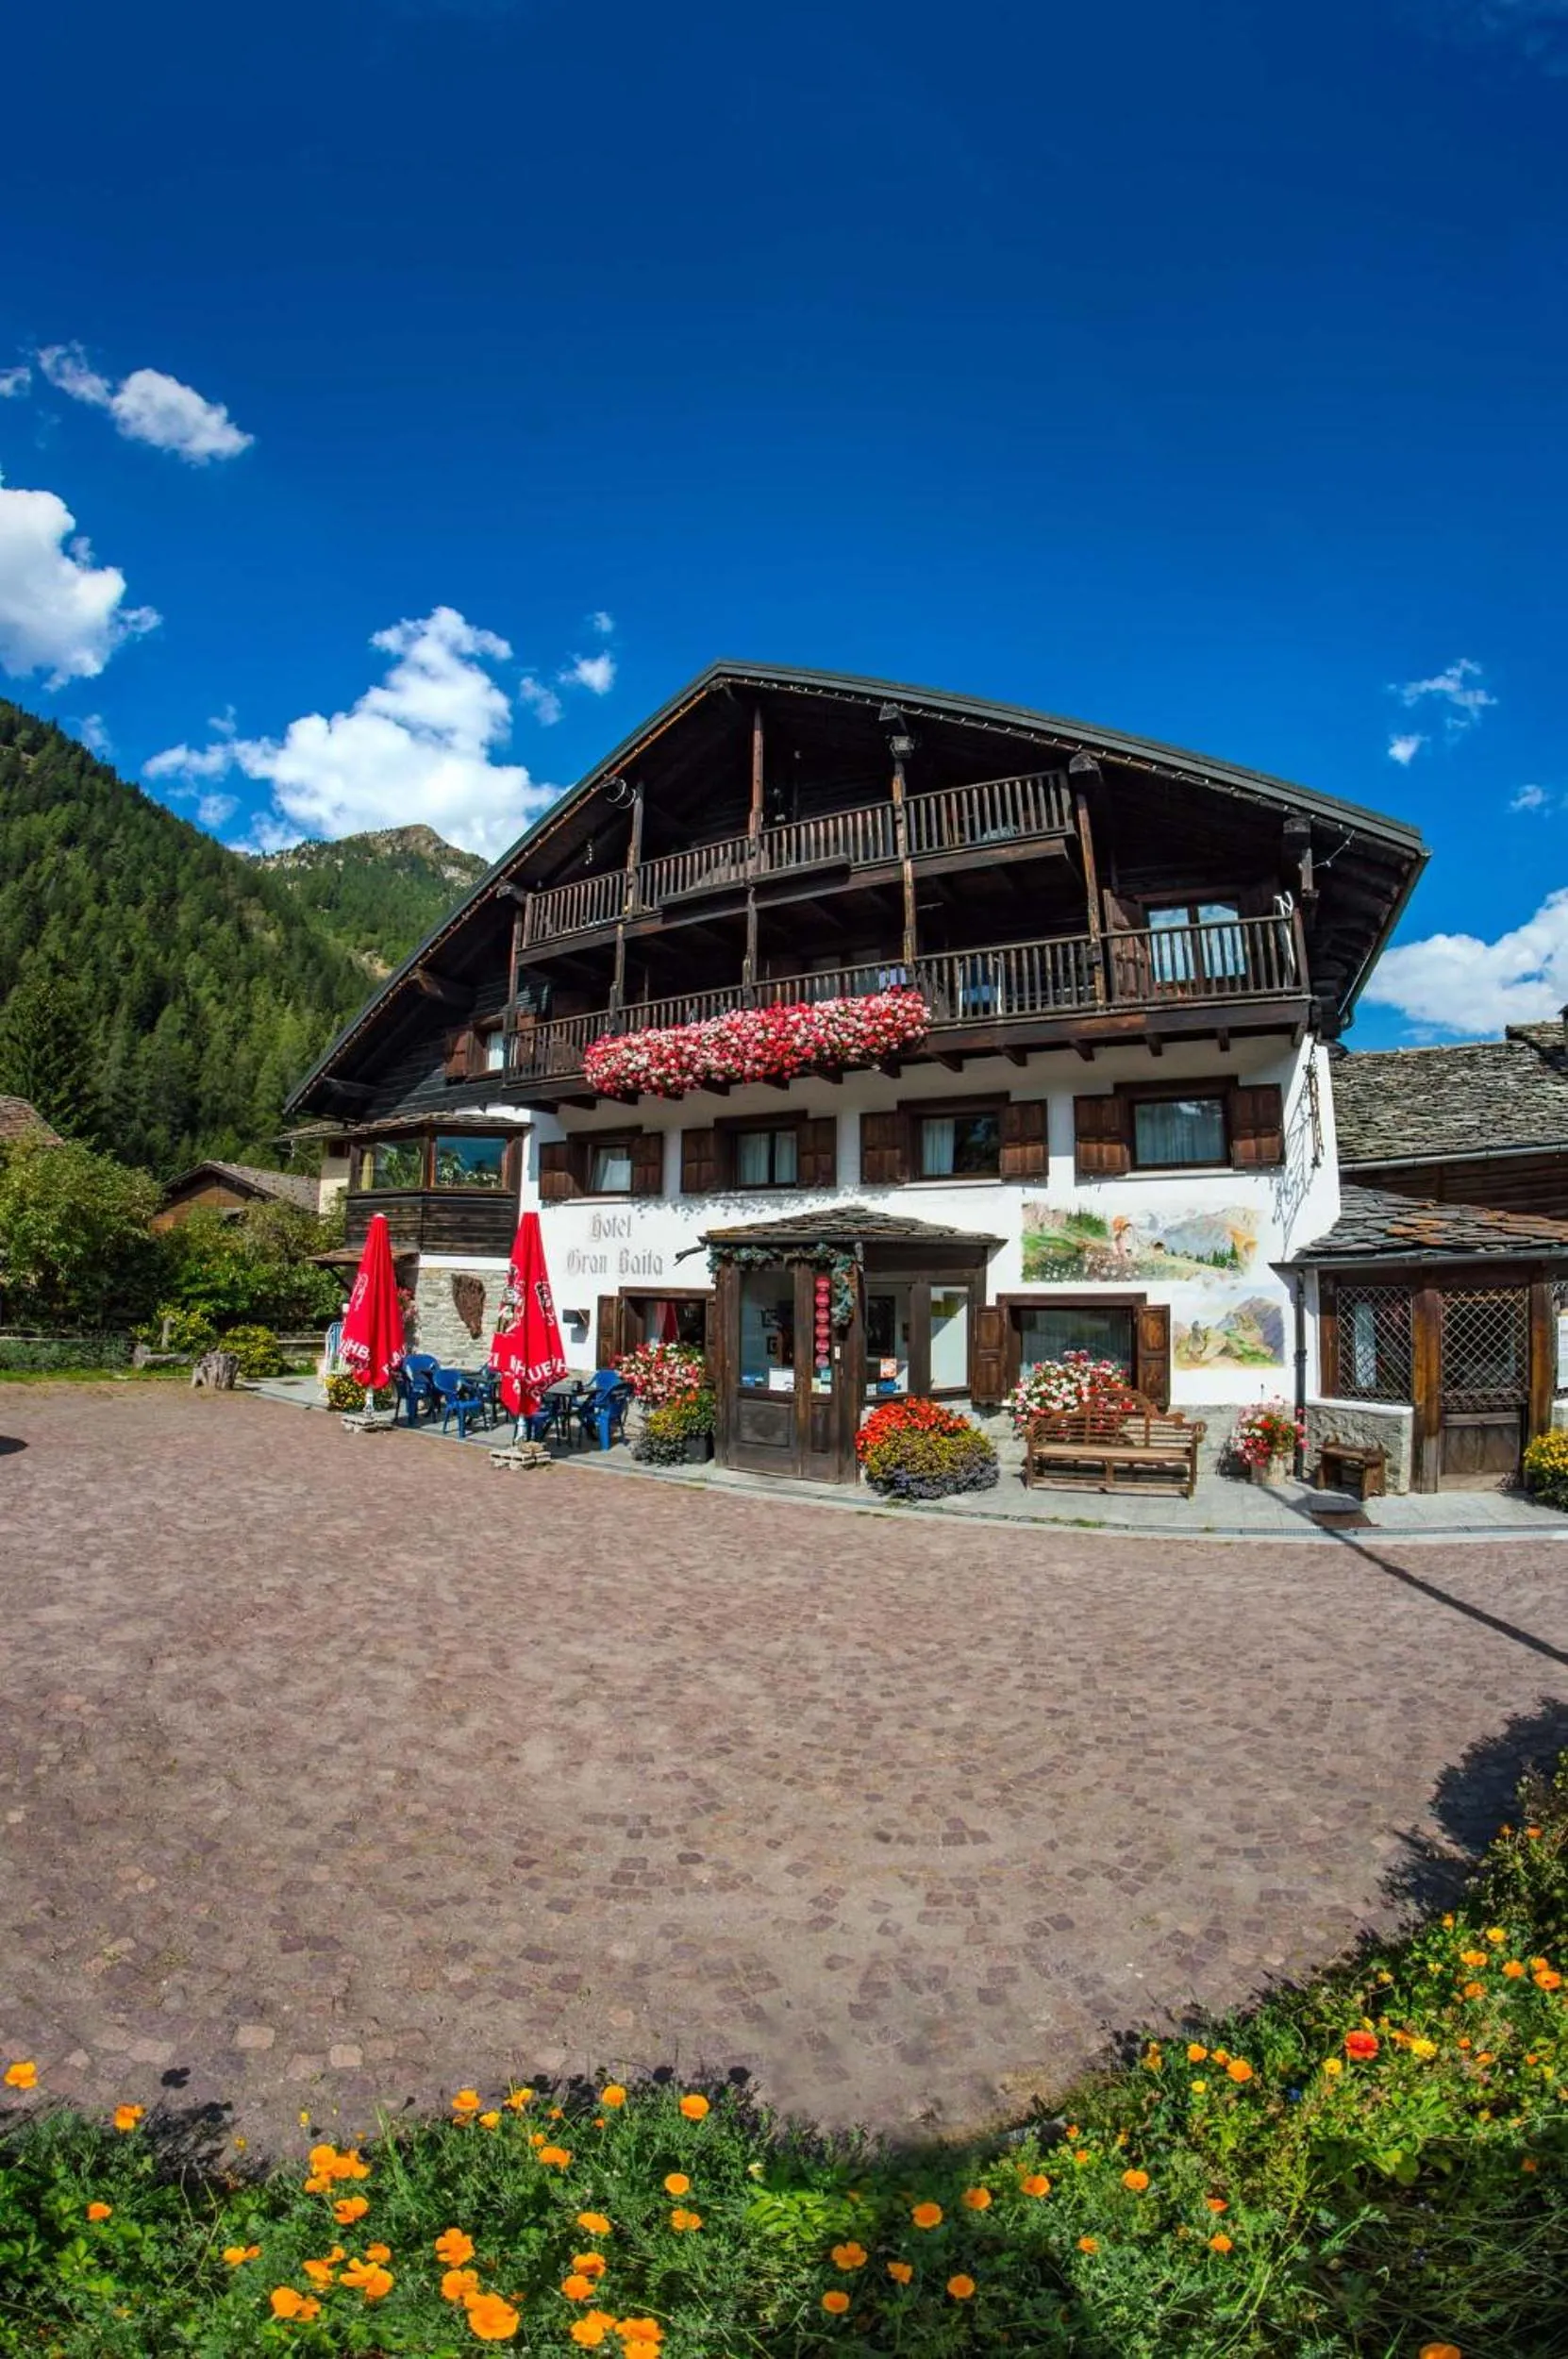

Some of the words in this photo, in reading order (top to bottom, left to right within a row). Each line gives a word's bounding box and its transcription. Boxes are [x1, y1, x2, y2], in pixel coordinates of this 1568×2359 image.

[591, 1213, 631, 1241] Hotel
[567, 1248, 607, 1275] Gran
[618, 1247, 663, 1277] Baita
